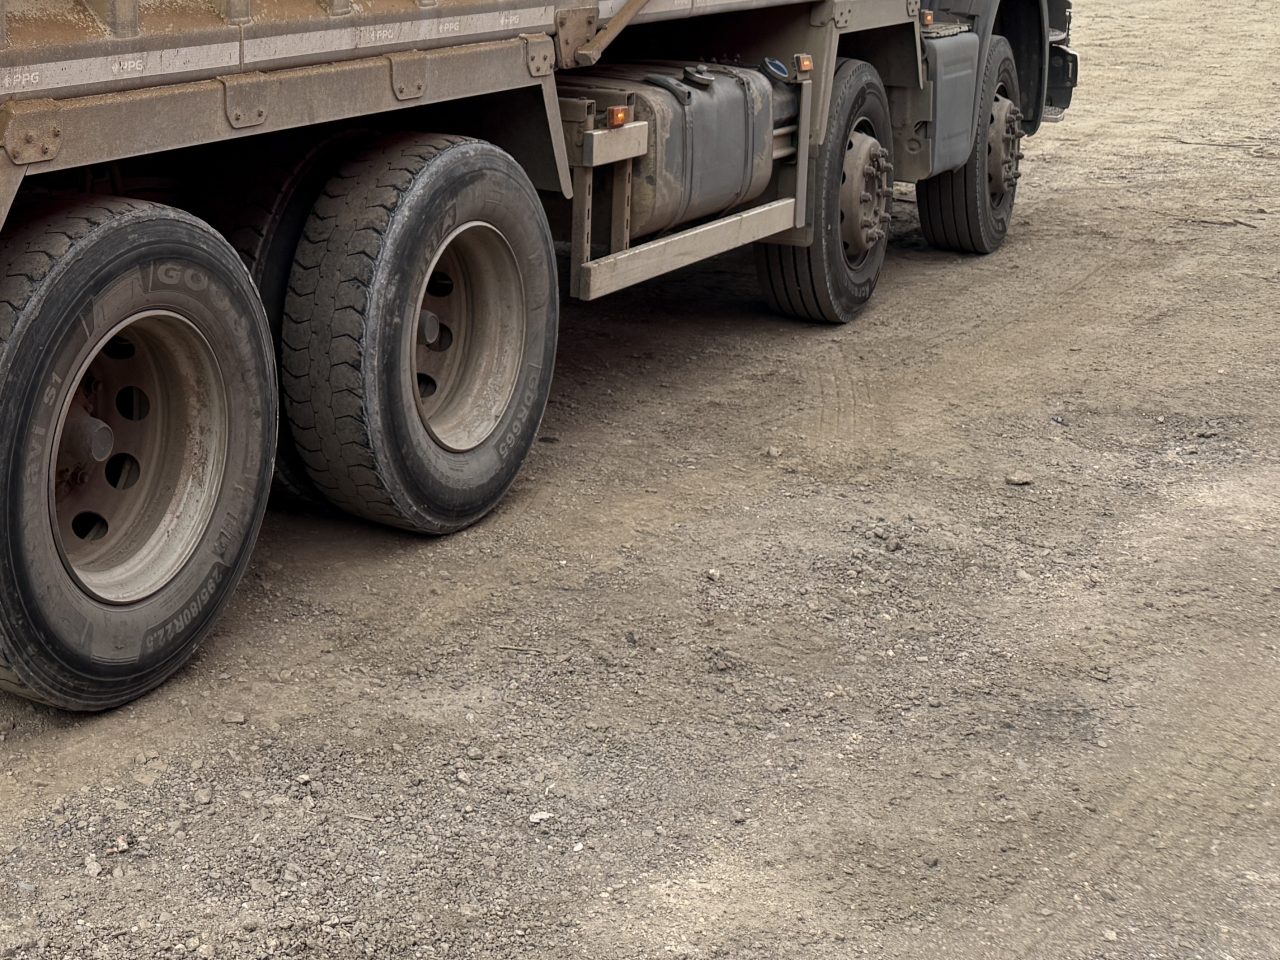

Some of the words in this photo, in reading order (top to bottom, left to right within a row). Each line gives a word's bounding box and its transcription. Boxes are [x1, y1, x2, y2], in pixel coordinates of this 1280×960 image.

[444, 22, 460, 32] PPG
[120, 59, 144, 72] PPG
[12, 72, 40, 87] PPG
